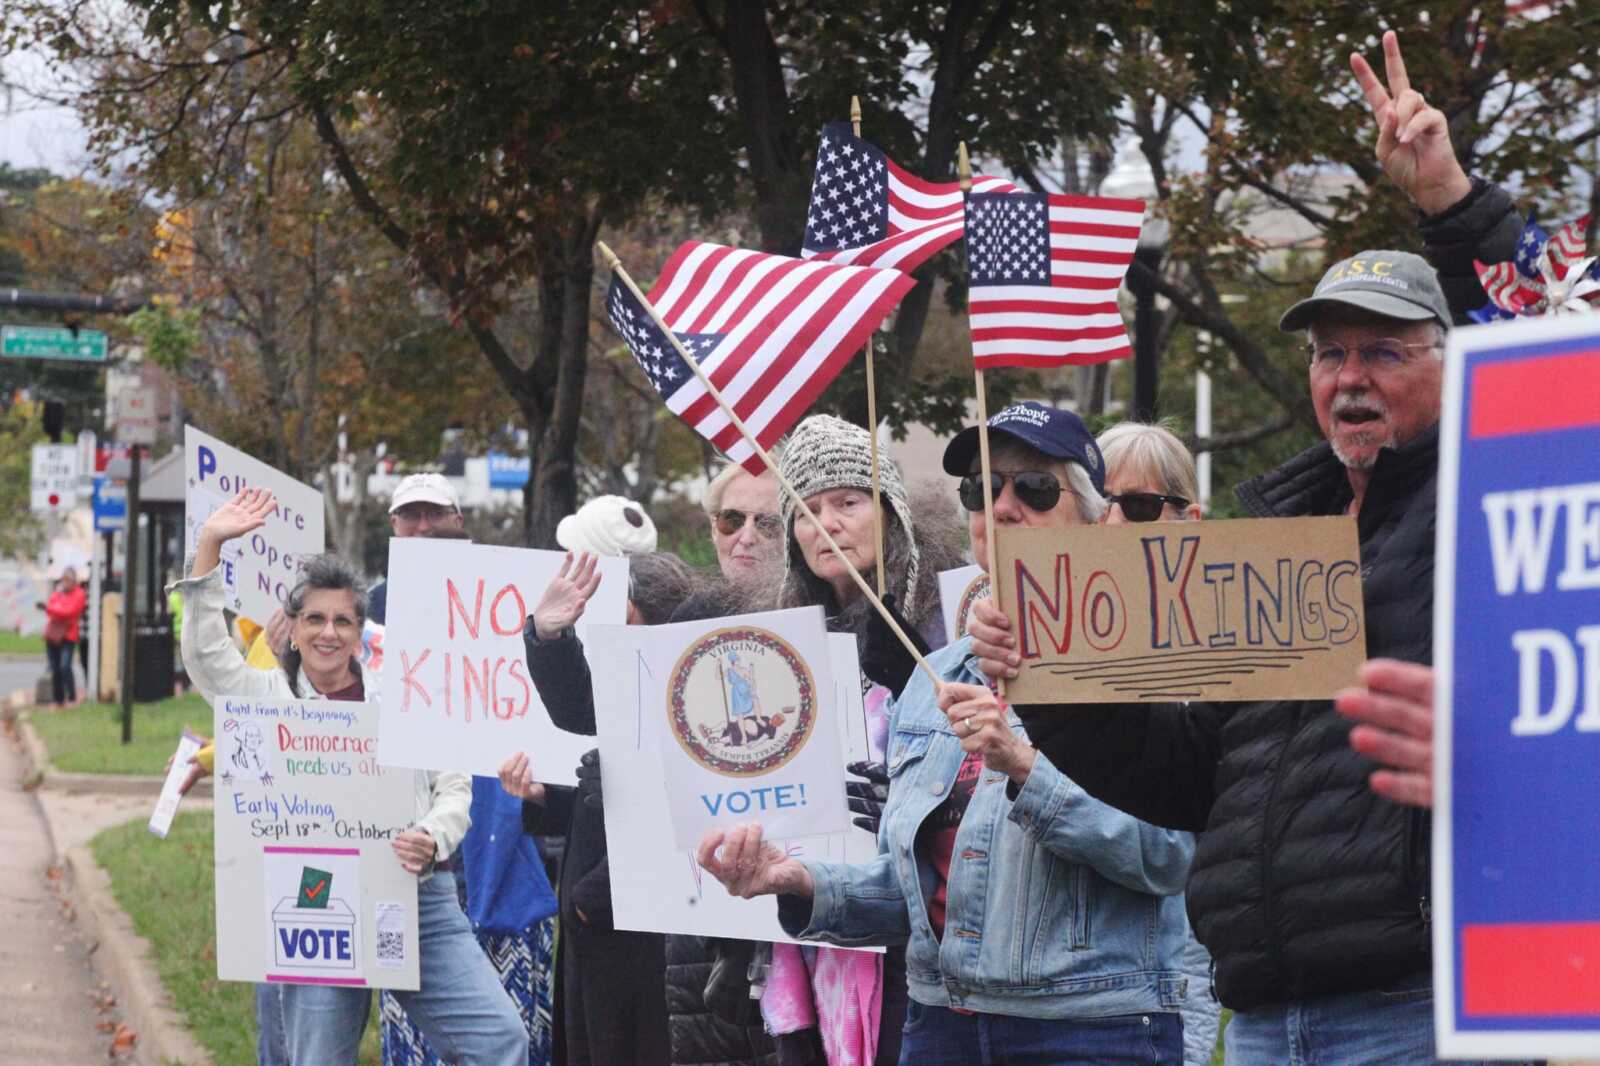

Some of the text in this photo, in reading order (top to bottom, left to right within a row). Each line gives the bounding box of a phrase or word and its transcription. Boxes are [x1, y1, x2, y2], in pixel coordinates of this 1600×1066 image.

[1010, 404, 1050, 423] People
[1010, 415, 1045, 427] ENOUGH
[197, 444, 253, 495] Poll
[447, 578, 527, 640] NO
[708, 641, 766, 659] VIRGINIA
[400, 648, 530, 723] KINGS
[225, 703, 250, 716] Right
[256, 704, 279, 716] from
[278, 723, 378, 753] Democrac
[286, 757, 328, 777] needs
[331, 759, 351, 776] us
[719, 750, 752, 760] SEMPER
[233, 792, 335, 823] Early Voting
[701, 783, 807, 816] VOTE!
[251, 819, 289, 840] Sept
[334, 819, 392, 840] October
[279, 928, 351, 960] VOTE
